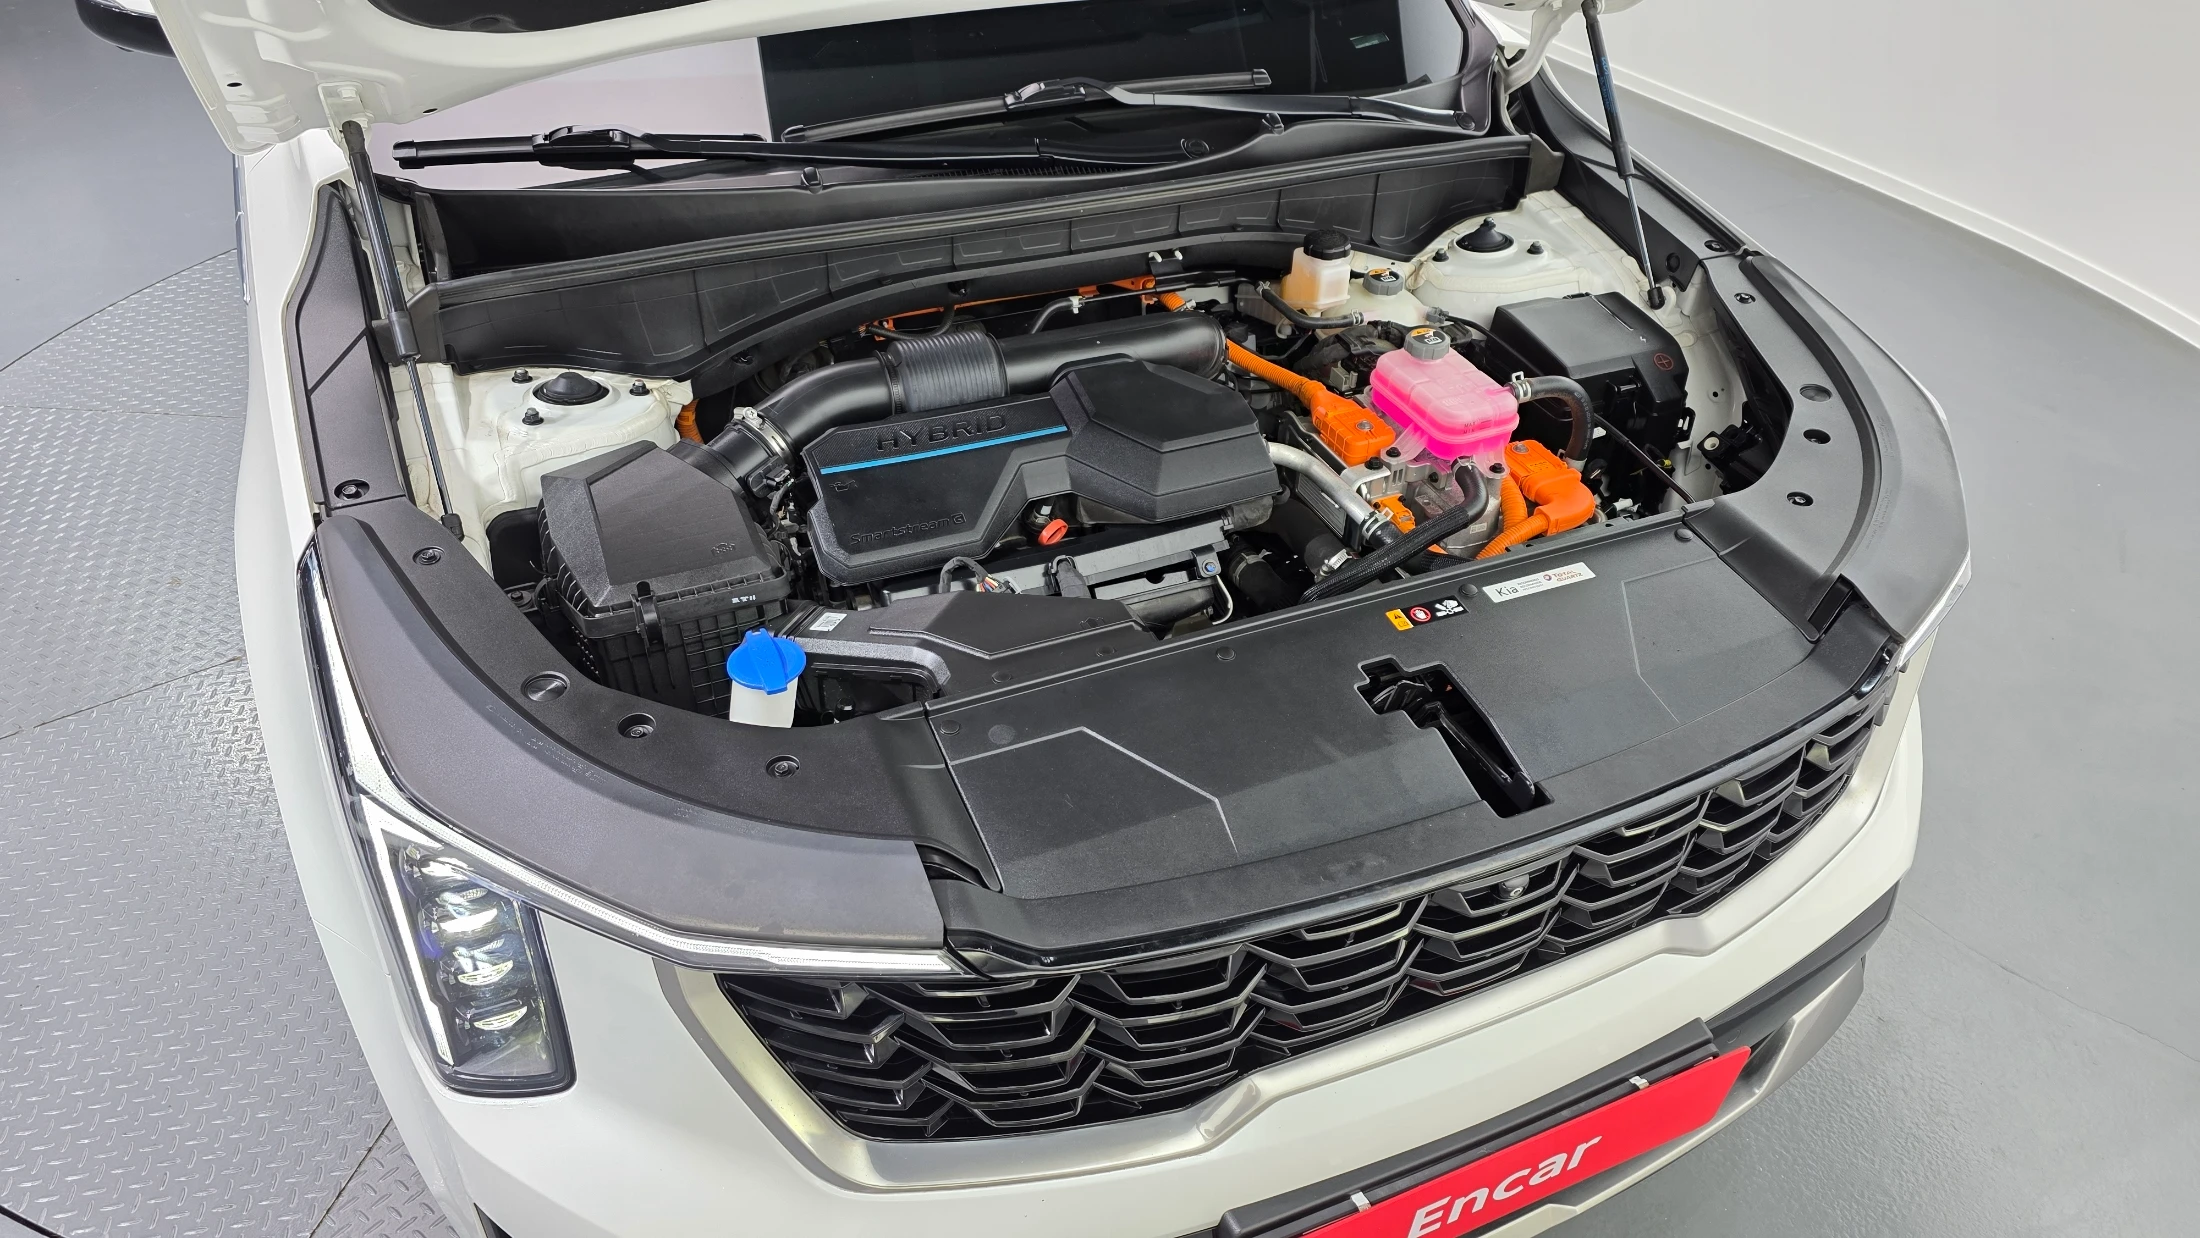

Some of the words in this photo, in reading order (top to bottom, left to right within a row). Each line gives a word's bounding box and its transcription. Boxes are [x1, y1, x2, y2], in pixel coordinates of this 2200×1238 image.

[877, 414, 1007, 452] HYBRID
[850, 517, 950, 545] Smartstream
[1494, 586, 1520, 597] Kia
[1407, 1135, 1603, 1238] Encar
